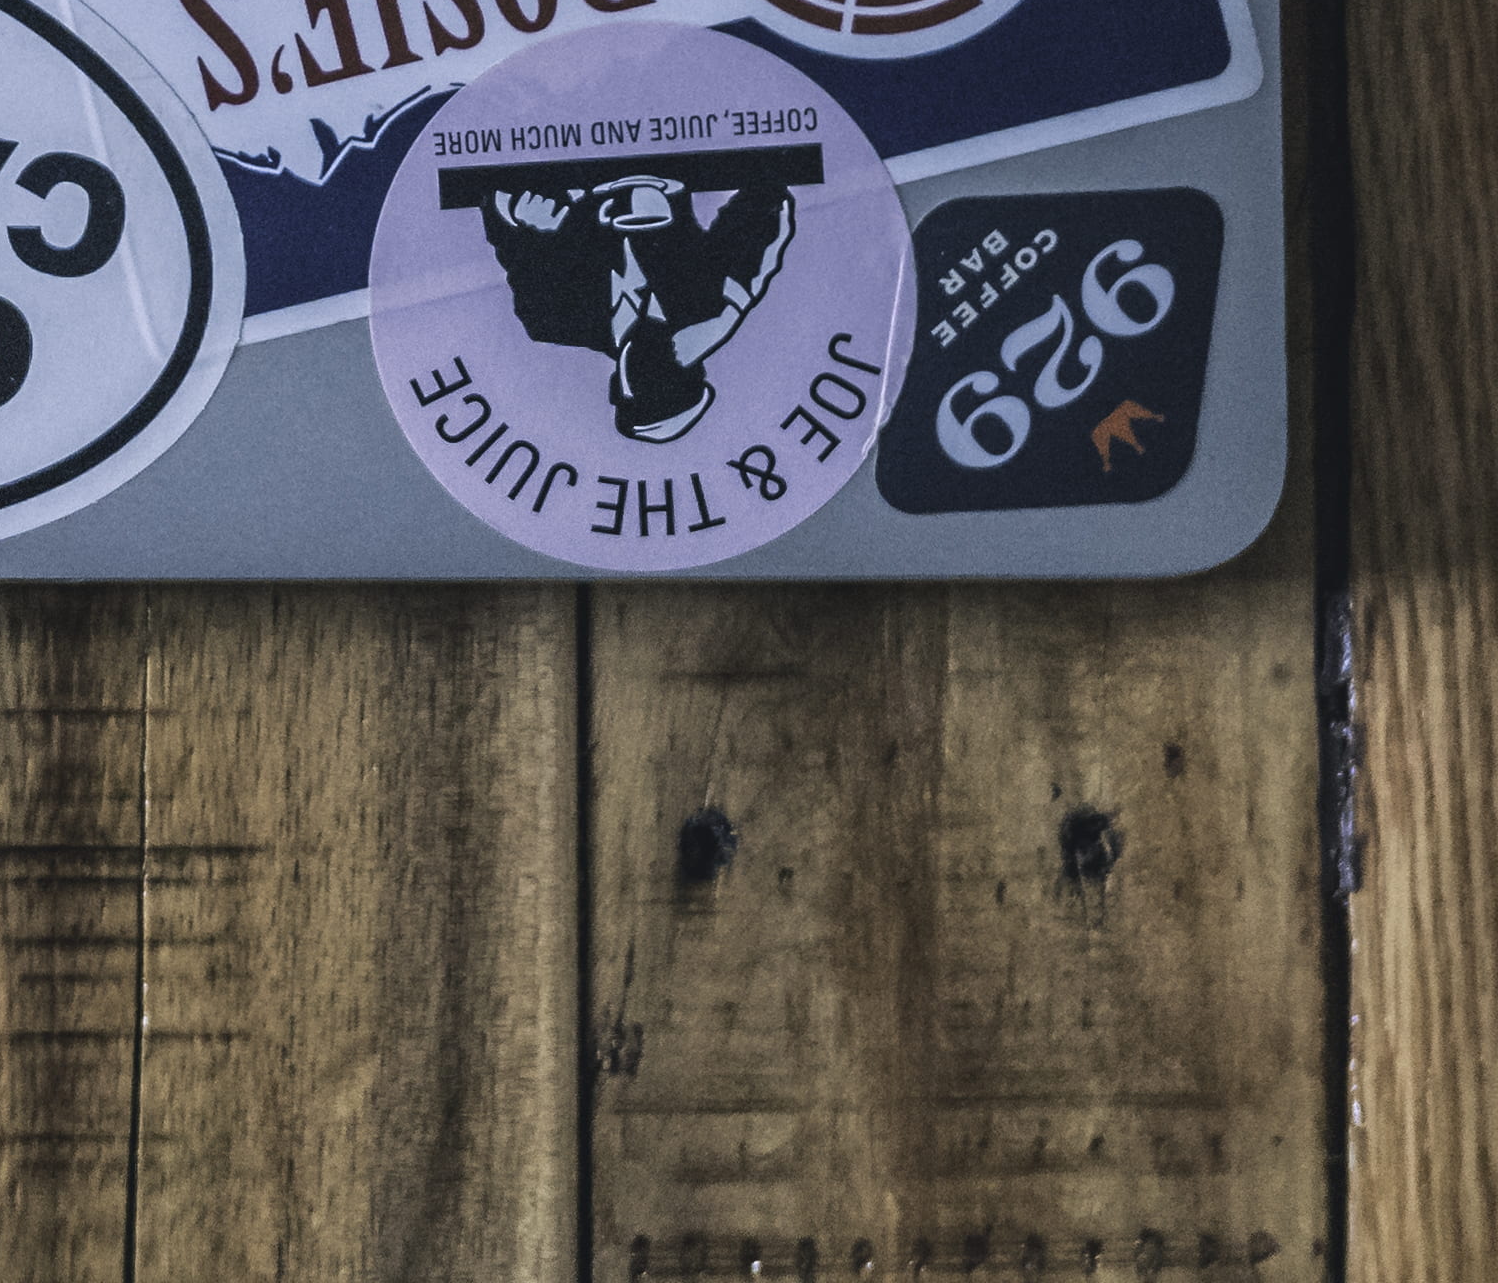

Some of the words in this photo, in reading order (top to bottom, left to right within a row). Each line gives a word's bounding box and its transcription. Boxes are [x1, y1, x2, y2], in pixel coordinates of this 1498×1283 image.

[433, 129, 502, 156] MORE
[511, 123, 582, 150] MUCH
[591, 119, 641, 145] AND
[649, 115, 717, 141] JUICE
[722, 107, 818, 135] COFFEE,
[930, 228, 1059, 349] COFFEE
[937, 228, 1010, 296] BAR
[935, 238, 1176, 469] 929
[780, 332, 882, 464] JOE
[409, 356, 579, 513] JUICE
[726, 444, 788, 501] &
[590, 472, 726, 537] THE
